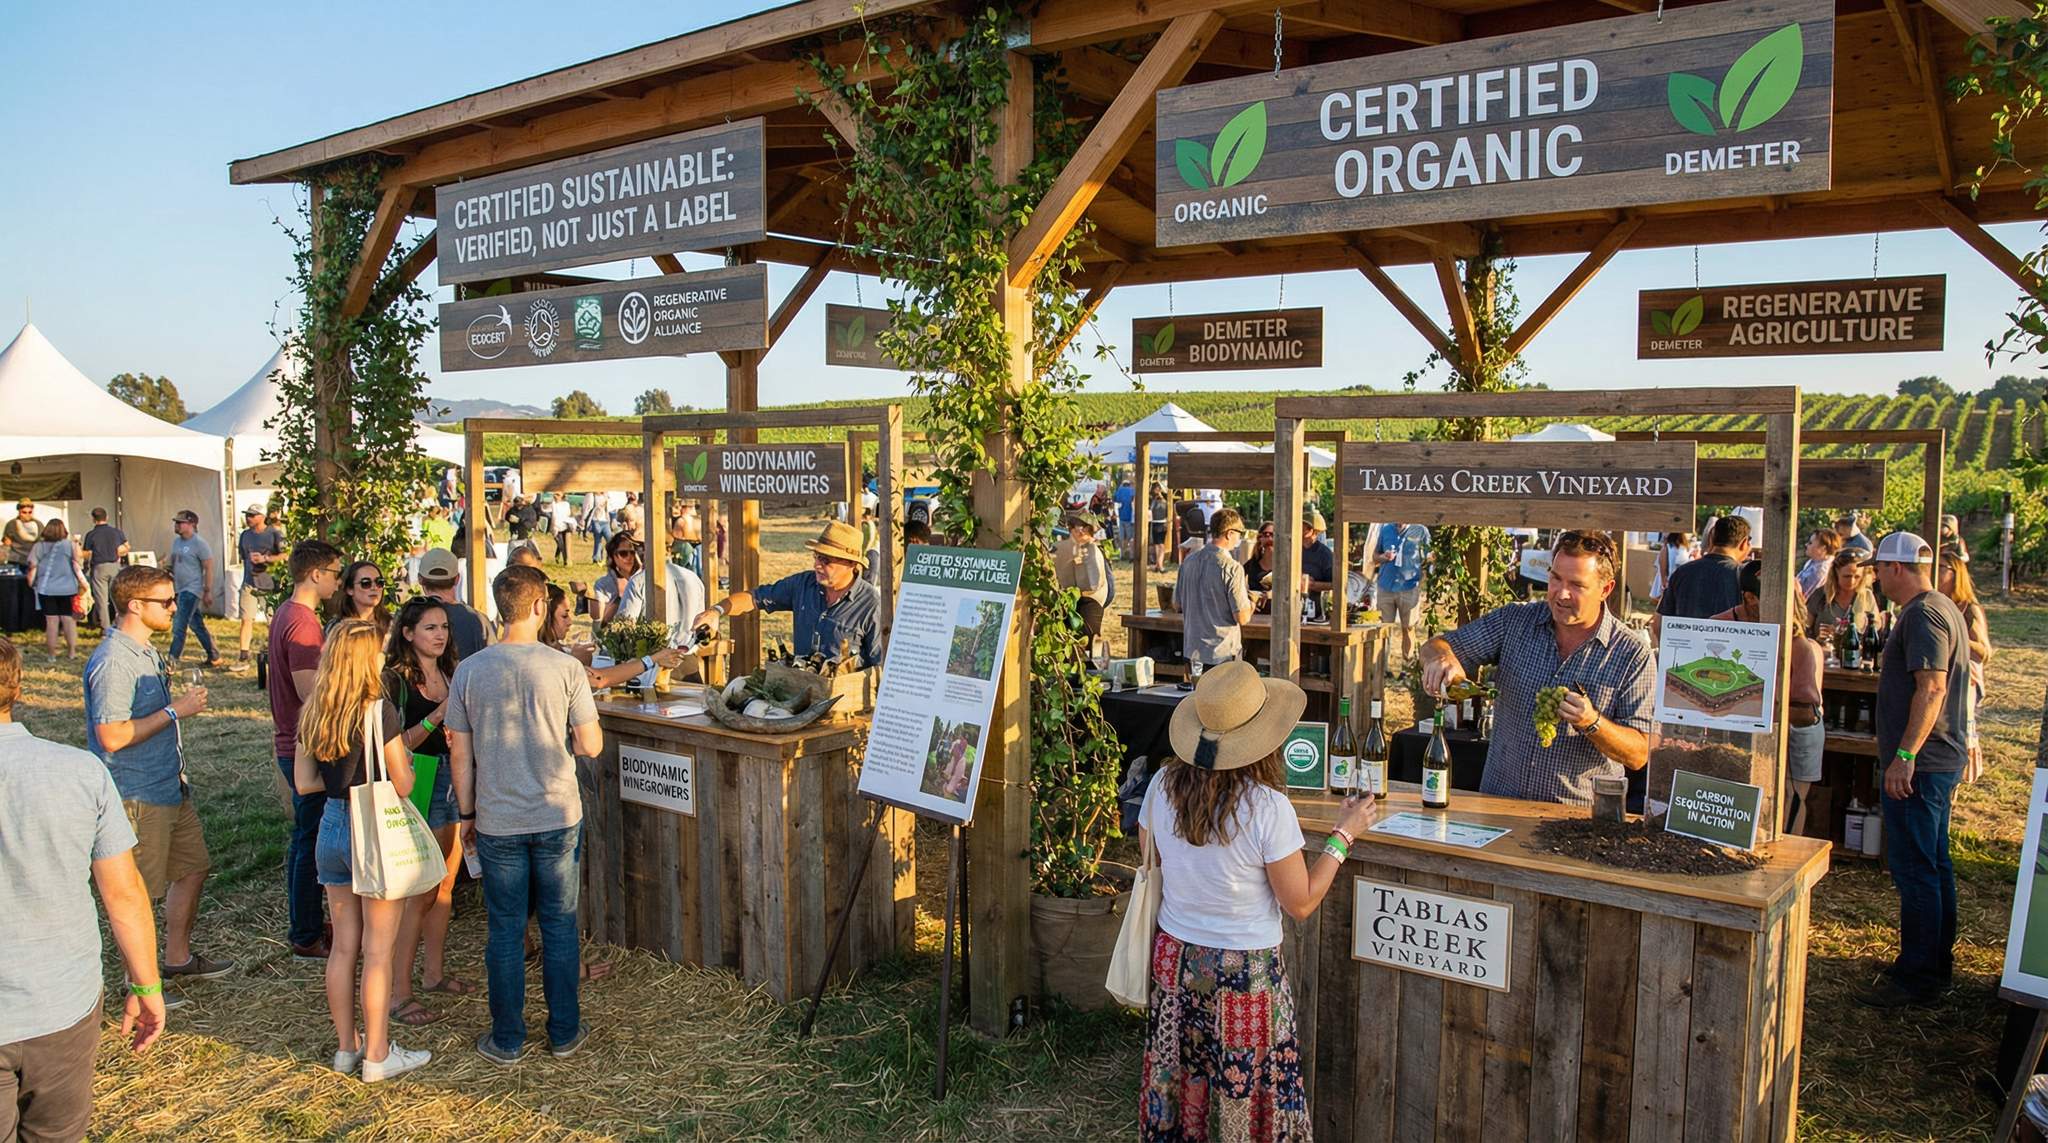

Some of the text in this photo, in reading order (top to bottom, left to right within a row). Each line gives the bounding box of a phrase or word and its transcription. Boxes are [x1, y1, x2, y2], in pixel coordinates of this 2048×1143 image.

[1319, 58, 1599, 142] CERTIFIED
[1333, 124, 1584, 198] ORGANIC
[1664, 140, 1801, 176] DEMETER
[455, 147, 735, 230] CERTIFIED SUSTAINABLE:
[1174, 194, 1269, 224] ORGANIC
[455, 191, 737, 264] VERIFIED, NOT JUST A LABEL
[653, 288, 727, 307] REGENERATIVE
[1722, 287, 1924, 318] REGENERATIVE
[653, 307, 699, 322] ORGANIC
[653, 321, 702, 337] ALLIANCE
[1203, 318, 1288, 341] DEMETER
[1728, 316, 1914, 346] AGRICULTURE
[1189, 340, 1304, 363] BIODYNAMIC
[1650, 339, 1703, 351] DEMETER
[722, 450, 817, 471] BIODYNAMIC
[719, 474, 830, 495] WINEGROWERS
[622, 757, 689, 783] BIODYNAMIC
[622, 776, 690, 801] WINEGROWERS
[1695, 789, 1734, 806] CARBON
[1675, 795, 1751, 822] SEQUESTRATION
[1687, 810, 1735, 830] IN ACTION
[1372, 887, 1489, 932] TABLAS
[1372, 916, 1488, 961] CREEK
[1371, 941, 1487, 979] VINEYARD
